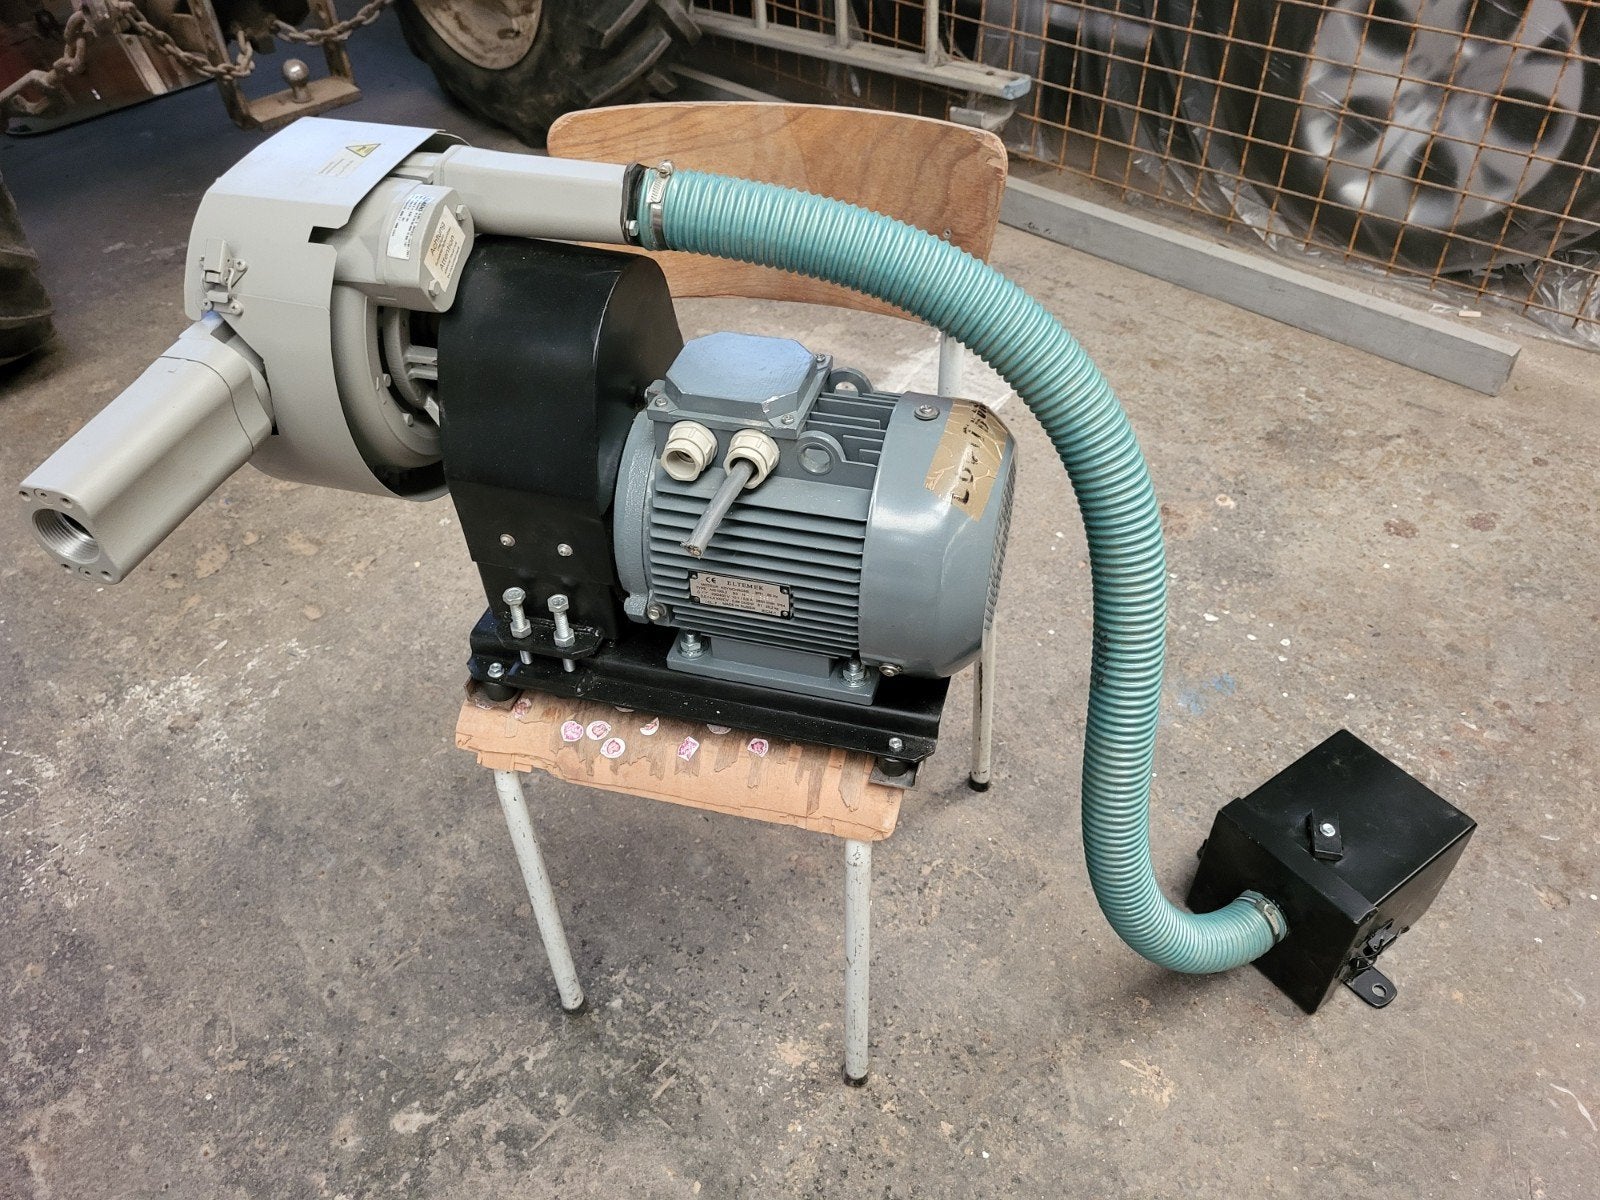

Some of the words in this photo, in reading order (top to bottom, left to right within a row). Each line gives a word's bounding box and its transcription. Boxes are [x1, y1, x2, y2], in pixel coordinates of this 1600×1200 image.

[430, 221, 446, 255] Achtung
[440, 234, 455, 271] Attention
[726, 581, 764, 591] ELTEMEK
